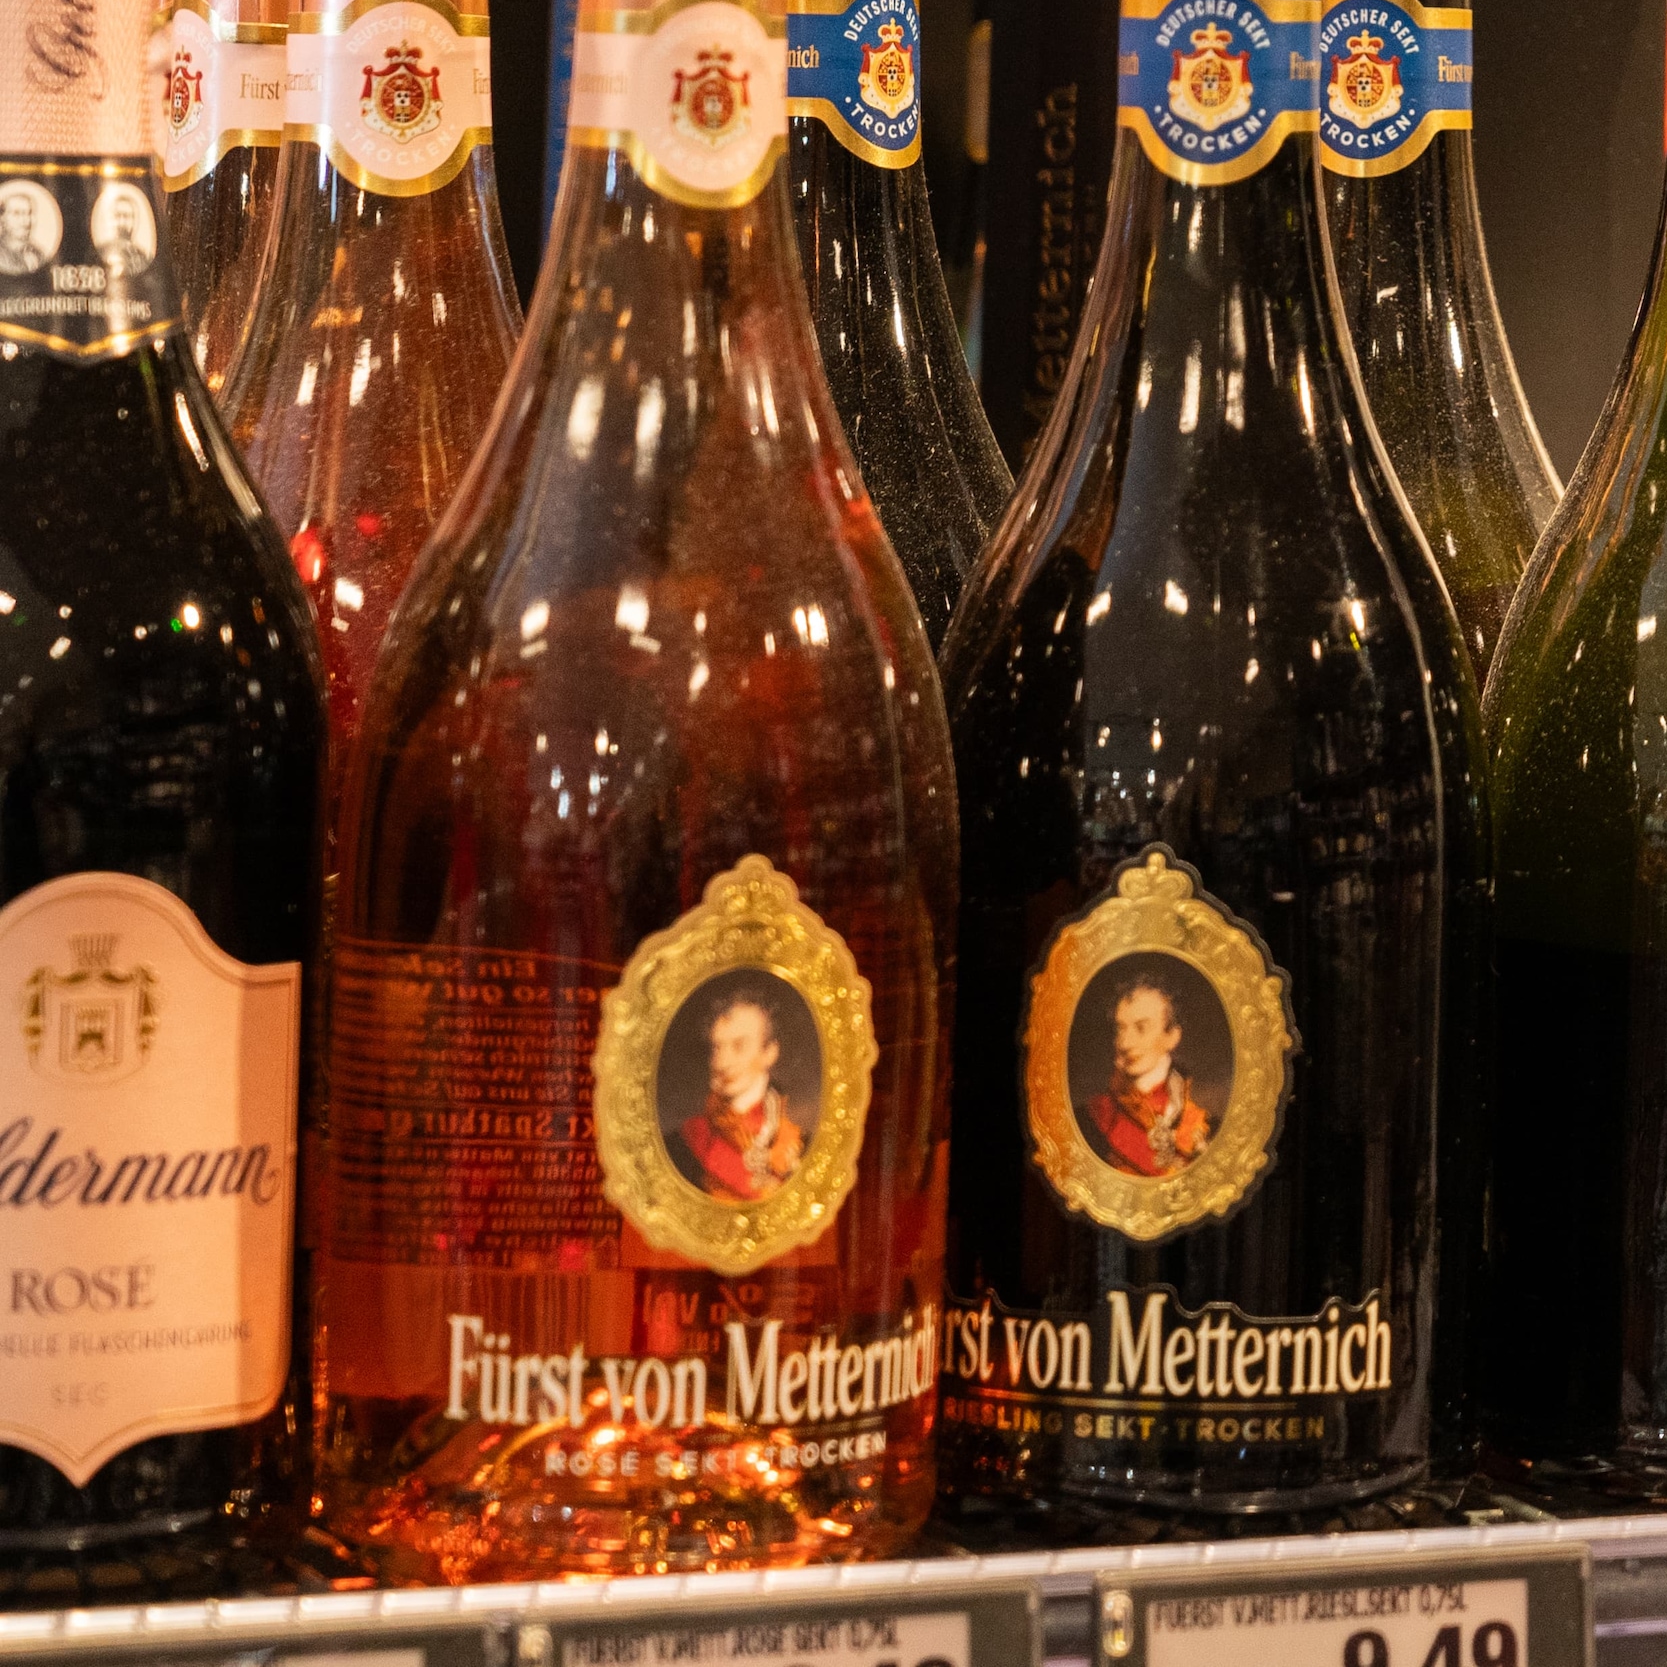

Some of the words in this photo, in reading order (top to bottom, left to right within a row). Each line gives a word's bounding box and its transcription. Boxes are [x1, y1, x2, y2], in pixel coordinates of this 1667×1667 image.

[1238, 10, 1271, 50] SEKT
[1319, 8, 1388, 54] DEUTSCHER
[1389, 18, 1420, 55] SEKT
[850, 100, 921, 140] TROCKEN
[1158, 113, 1261, 154] TROCKEN
[1319, 114, 1413, 149] TROCKEN
[10, 1254, 157, 1316] ROSÉ
[944, 1297, 994, 1382] rst
[1005, 1316, 1093, 1394] von
[1105, 1289, 1392, 1398] Metternich
[444, 1313, 590, 1429] Fürst
[601, 1354, 707, 1428] von
[725, 1303, 937, 1425] Metternich
[1074, 1411, 1154, 1442] SEKT
[1175, 1414, 1326, 1443] TROCKEN
[1154, 1599, 1227, 1632] FUERST
